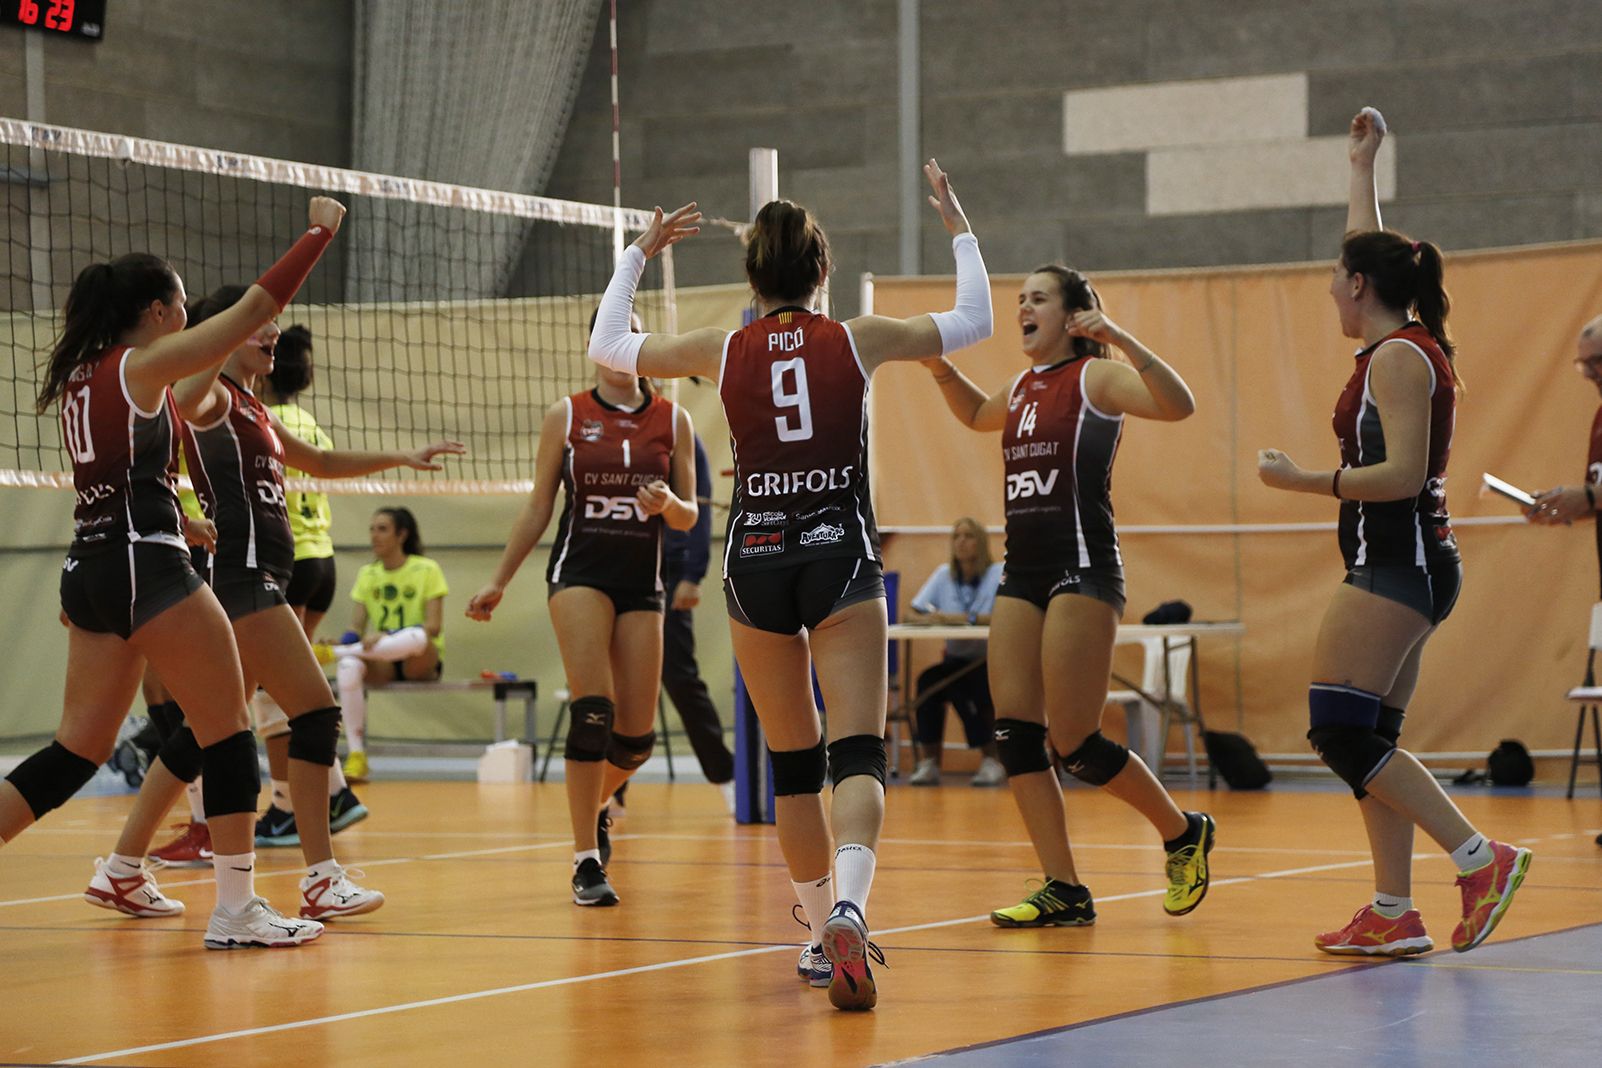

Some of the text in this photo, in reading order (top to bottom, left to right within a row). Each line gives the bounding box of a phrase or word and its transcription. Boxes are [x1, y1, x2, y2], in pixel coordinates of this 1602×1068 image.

[45, 0, 75, 32] 23
[768, 326, 804, 352] PICÓ
[771, 357, 814, 442] 9
[1016, 401, 1039, 438] 14
[621, 439, 631, 468] 1
[1012, 443, 1028, 460] SANT
[1029, 441, 1060, 458] CUGAT
[584, 472, 599, 485] CV
[600, 473, 630, 486] SANT
[747, 465, 854, 497] GRIFOLS
[1006, 468, 1060, 501] DSV
[742, 544, 782, 555] SECURITAS
